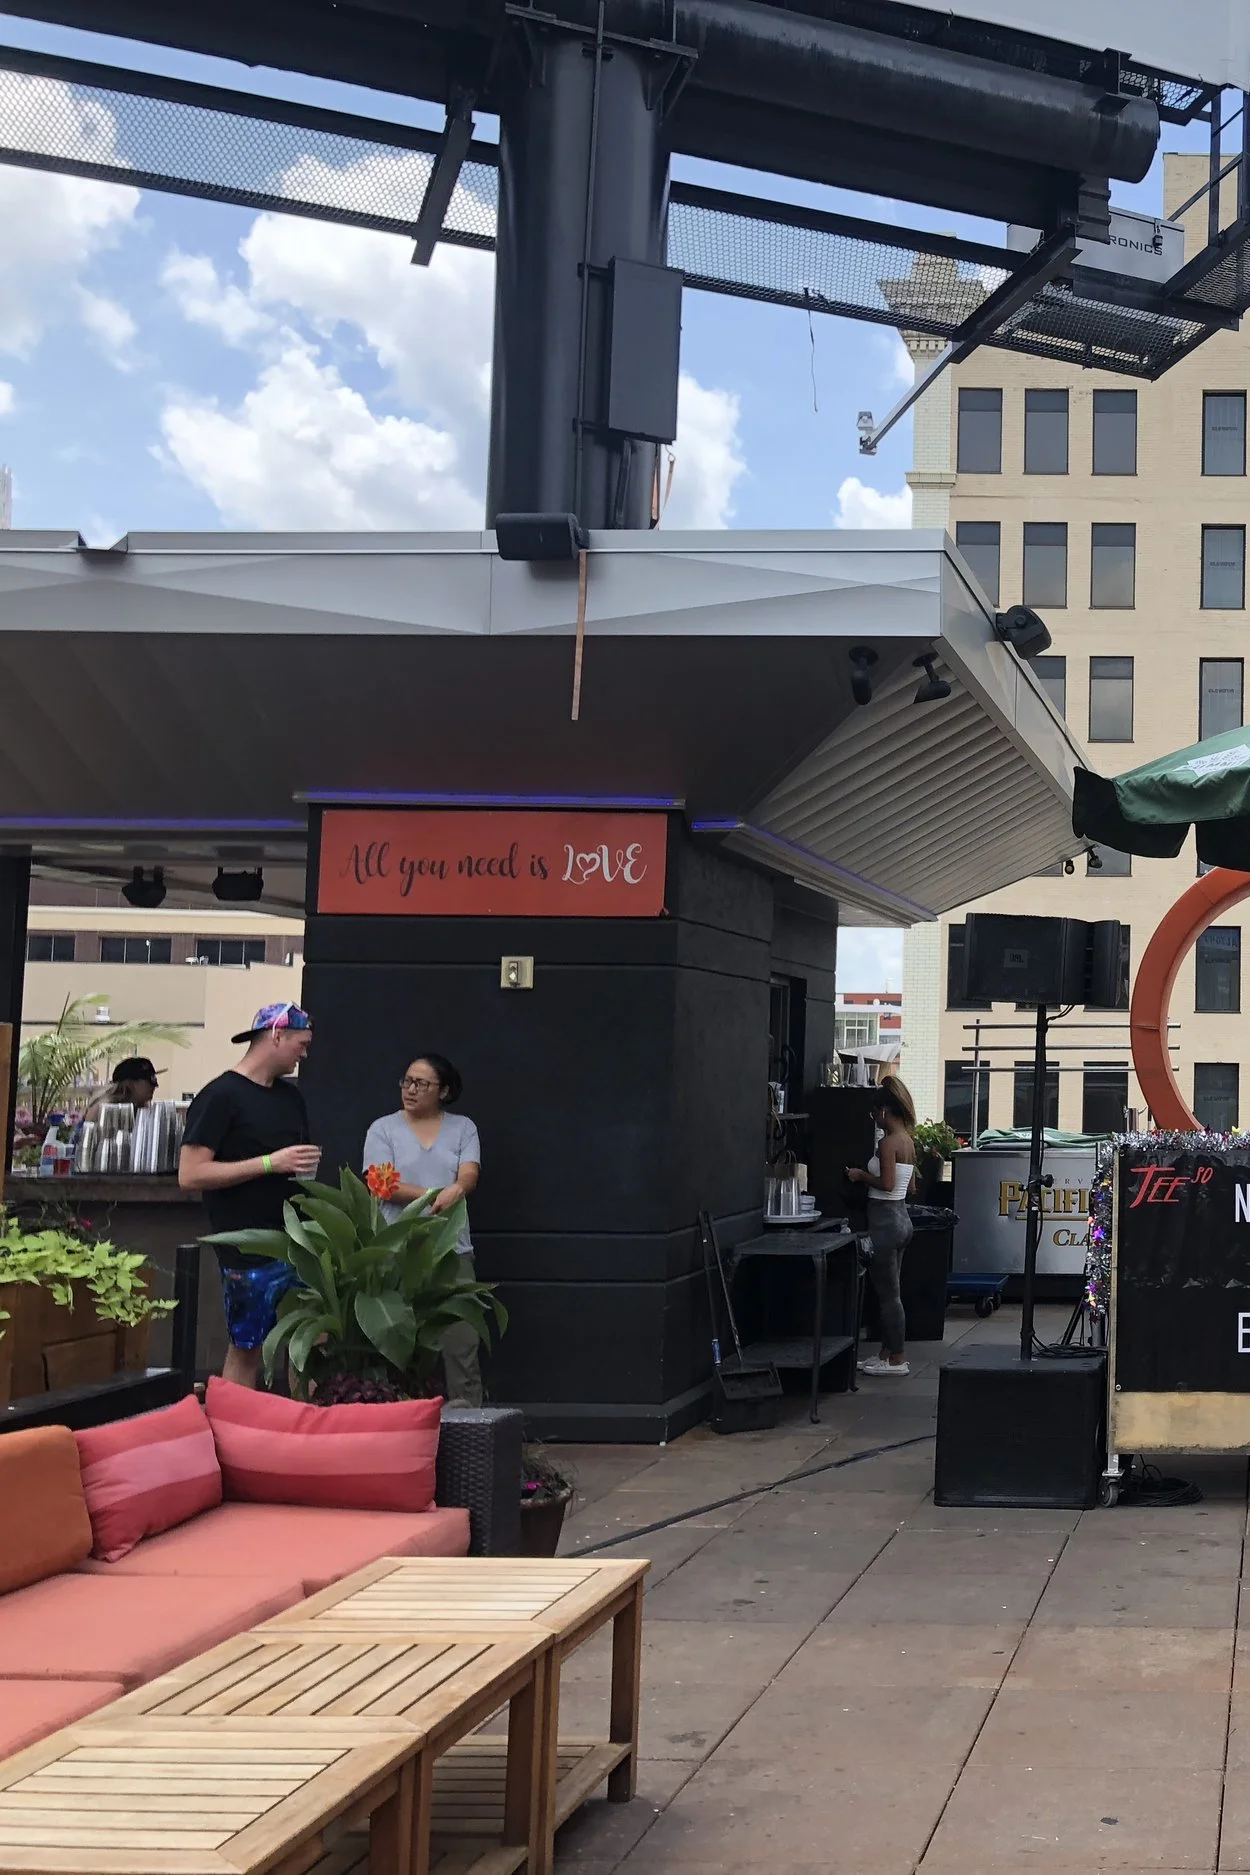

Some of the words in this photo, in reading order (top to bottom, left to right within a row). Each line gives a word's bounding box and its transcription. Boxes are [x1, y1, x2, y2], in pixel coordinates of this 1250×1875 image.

[339, 841, 391, 885] All
[399, 854, 449, 897] you
[458, 842, 520, 879] need
[529, 854, 550, 880] is
[561, 842, 648, 885] LOVE
[998, 1180, 1091, 1217] PCIFI
[1129, 1164, 1191, 1208] TEE
